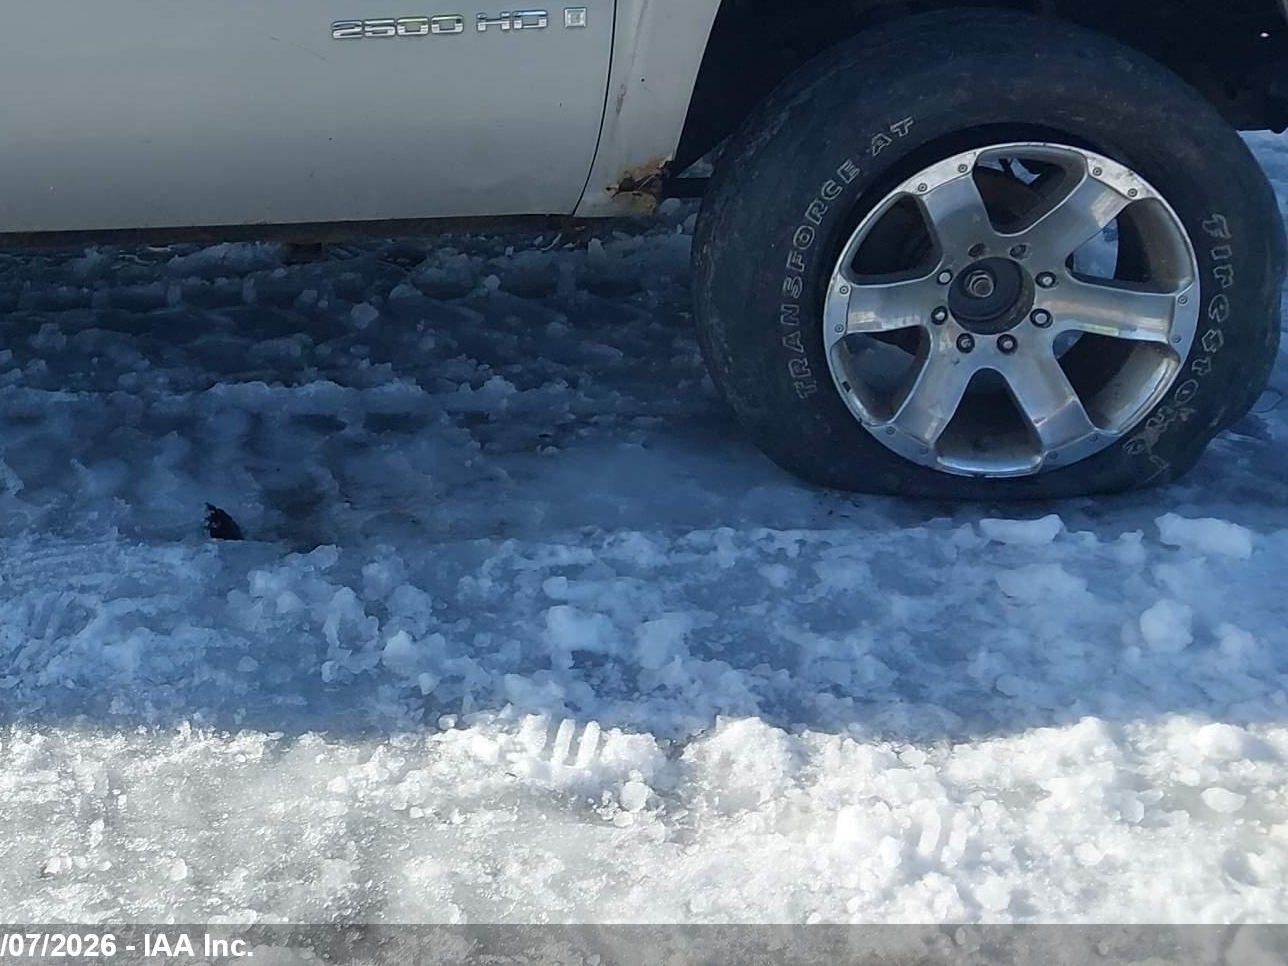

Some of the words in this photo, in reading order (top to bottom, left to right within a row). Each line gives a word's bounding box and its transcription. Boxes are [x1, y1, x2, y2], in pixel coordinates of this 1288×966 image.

[332, 14, 464, 39] 2500
[476, 9, 548, 32] HD
[781, 159, 860, 400] TRANSFORCE
[871, 117, 914, 158] AT
